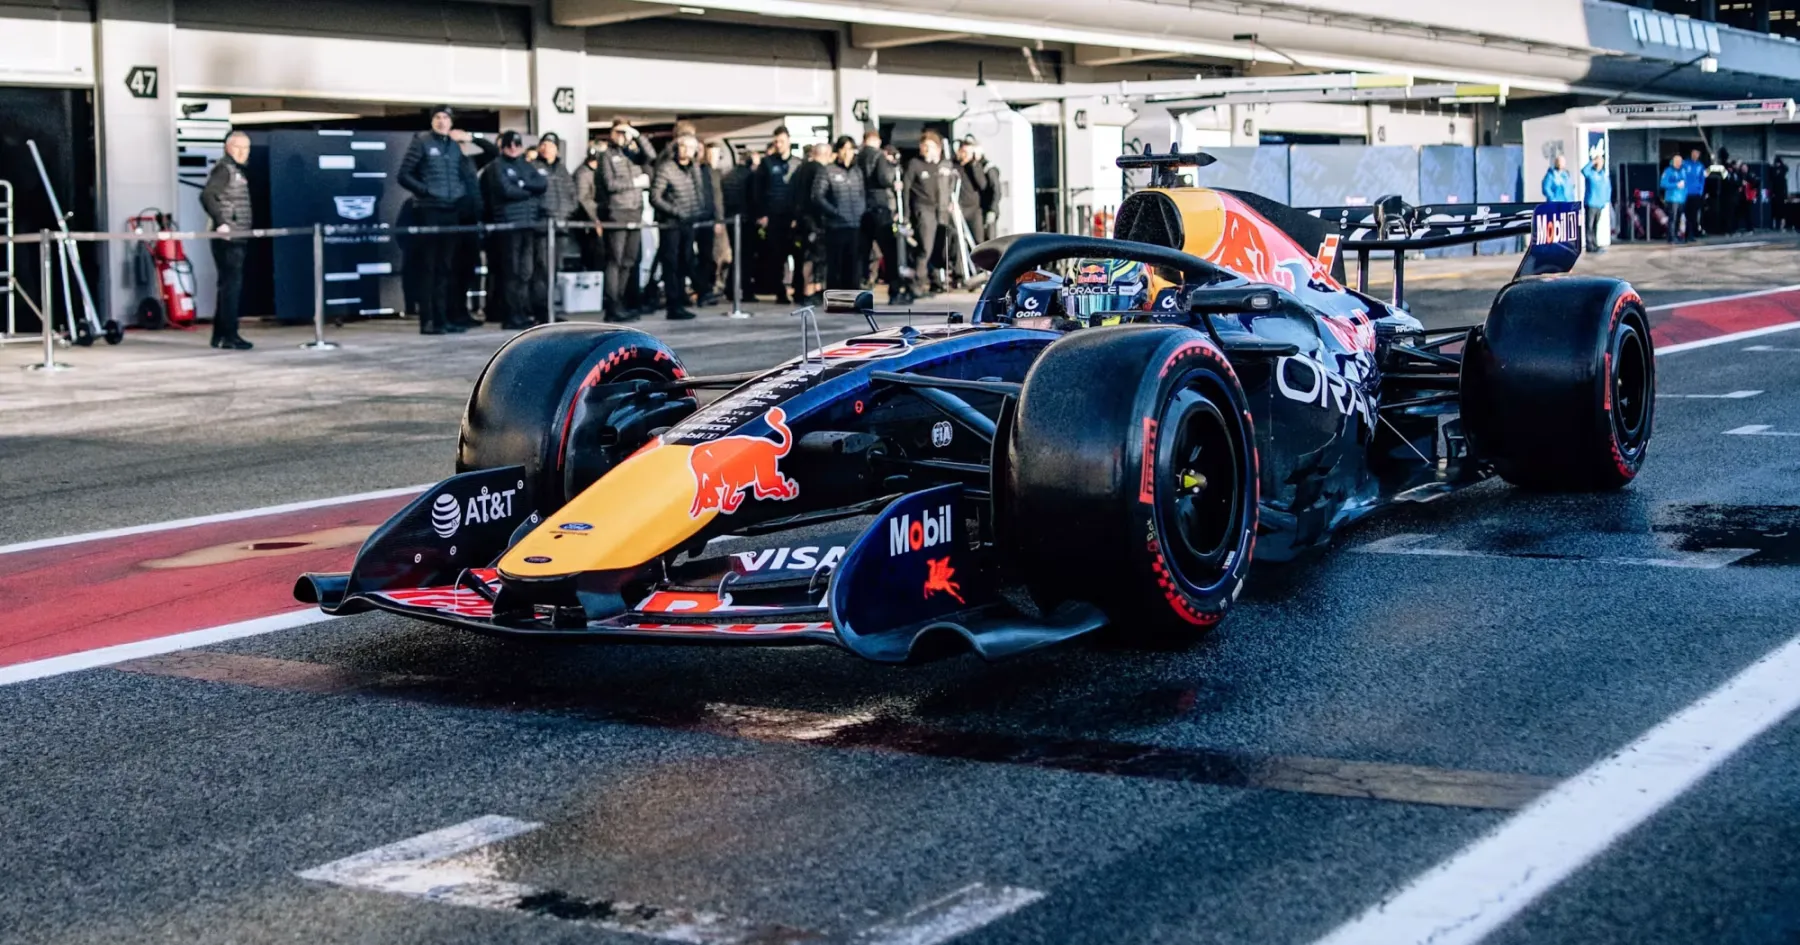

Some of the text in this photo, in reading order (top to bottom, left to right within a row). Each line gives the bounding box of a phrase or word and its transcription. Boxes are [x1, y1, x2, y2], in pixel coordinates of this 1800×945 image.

[130, 70, 156, 95] 47
[556, 90, 573, 110] 46
[1536, 212, 1566, 245] Mobil
[1069, 287, 1117, 295] ORACLE
[465, 489, 516, 526] AT&T
[890, 504, 952, 557] Mobil
[729, 546, 848, 572] VISA
